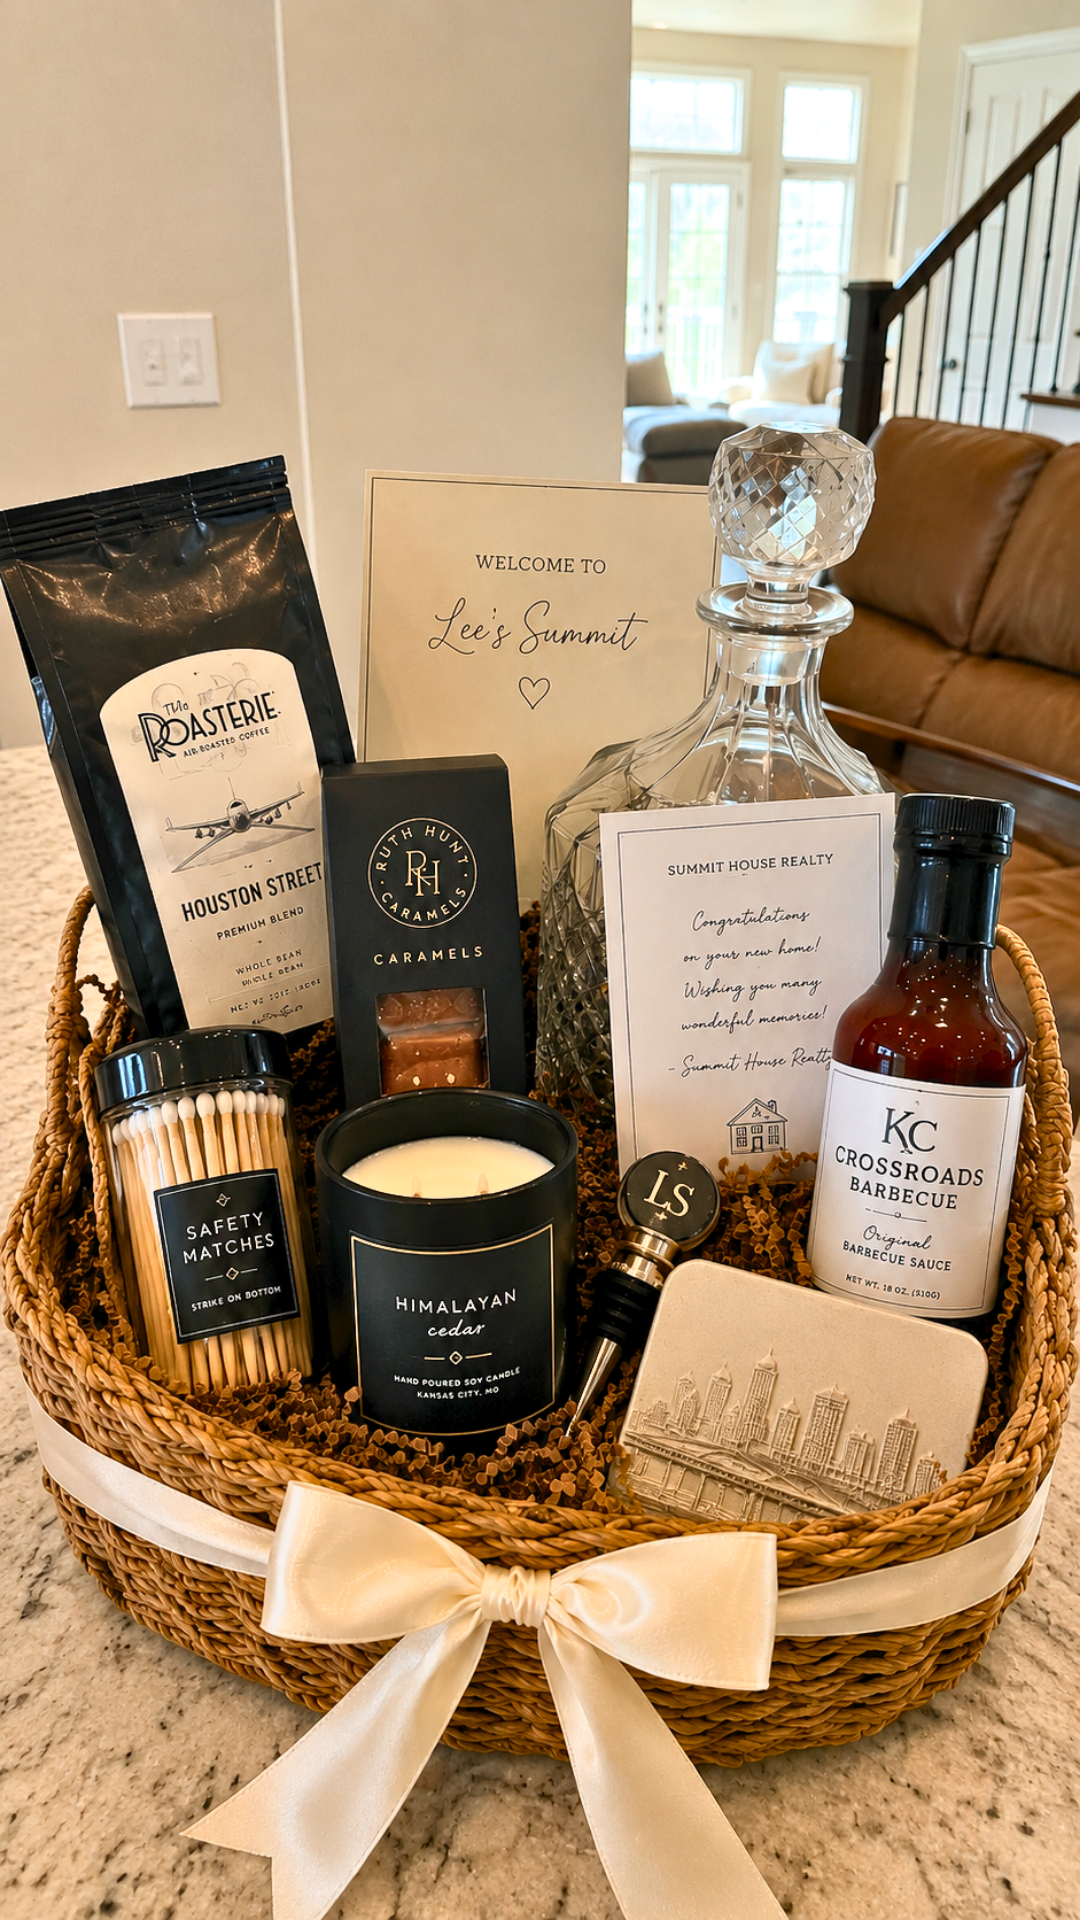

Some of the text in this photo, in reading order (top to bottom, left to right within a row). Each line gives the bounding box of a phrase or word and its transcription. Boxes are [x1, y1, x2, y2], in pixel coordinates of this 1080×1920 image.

[475, 554, 607, 575] WELCOME TO
[427, 596, 649, 656] Lee's Summit
[138, 691, 279, 763] ROASTERIE
[375, 824, 470, 872] RUTH HUNT
[667, 852, 834, 877] SUMMIT HOUSE REALTY
[180, 861, 323, 923] HOUSTON STREET
[380, 886, 468, 922] CARAMELS
[216, 905, 305, 941] PREMIUM BLEND
[691, 905, 811, 937] Congratulations
[372, 945, 484, 966] CARAMELS
[683, 935, 822, 971] on your new home!
[683, 977, 823, 1003] Wishing you many
[681, 1008, 756, 1035] wonderful
[680, 1053, 743, 1078] Summit
[744, 1051, 787, 1072] House
[881, 1106, 939, 1155] KC
[834, 1144, 985, 1187] CROSSROADS
[643, 1168, 695, 1217] LS
[849, 1175, 958, 1210] BARBECUE
[186, 1211, 264, 1241] SAFETY
[862, 1224, 933, 1251] Original
[182, 1233, 275, 1265] MATCHES
[842, 1239, 952, 1272] BARBECUE SAUCE
[845, 1273, 863, 1285] NET
[191, 1285, 282, 1313] STRIKE ON BOTTOM
[395, 1287, 517, 1315] HIMALAYAN
[427, 1318, 486, 1338] cedar
[393, 1365, 521, 1388] HAND POURED SOY CANDLE
[416, 1390, 455, 1400] KANSAS
[484, 1385, 500, 1395] MO
